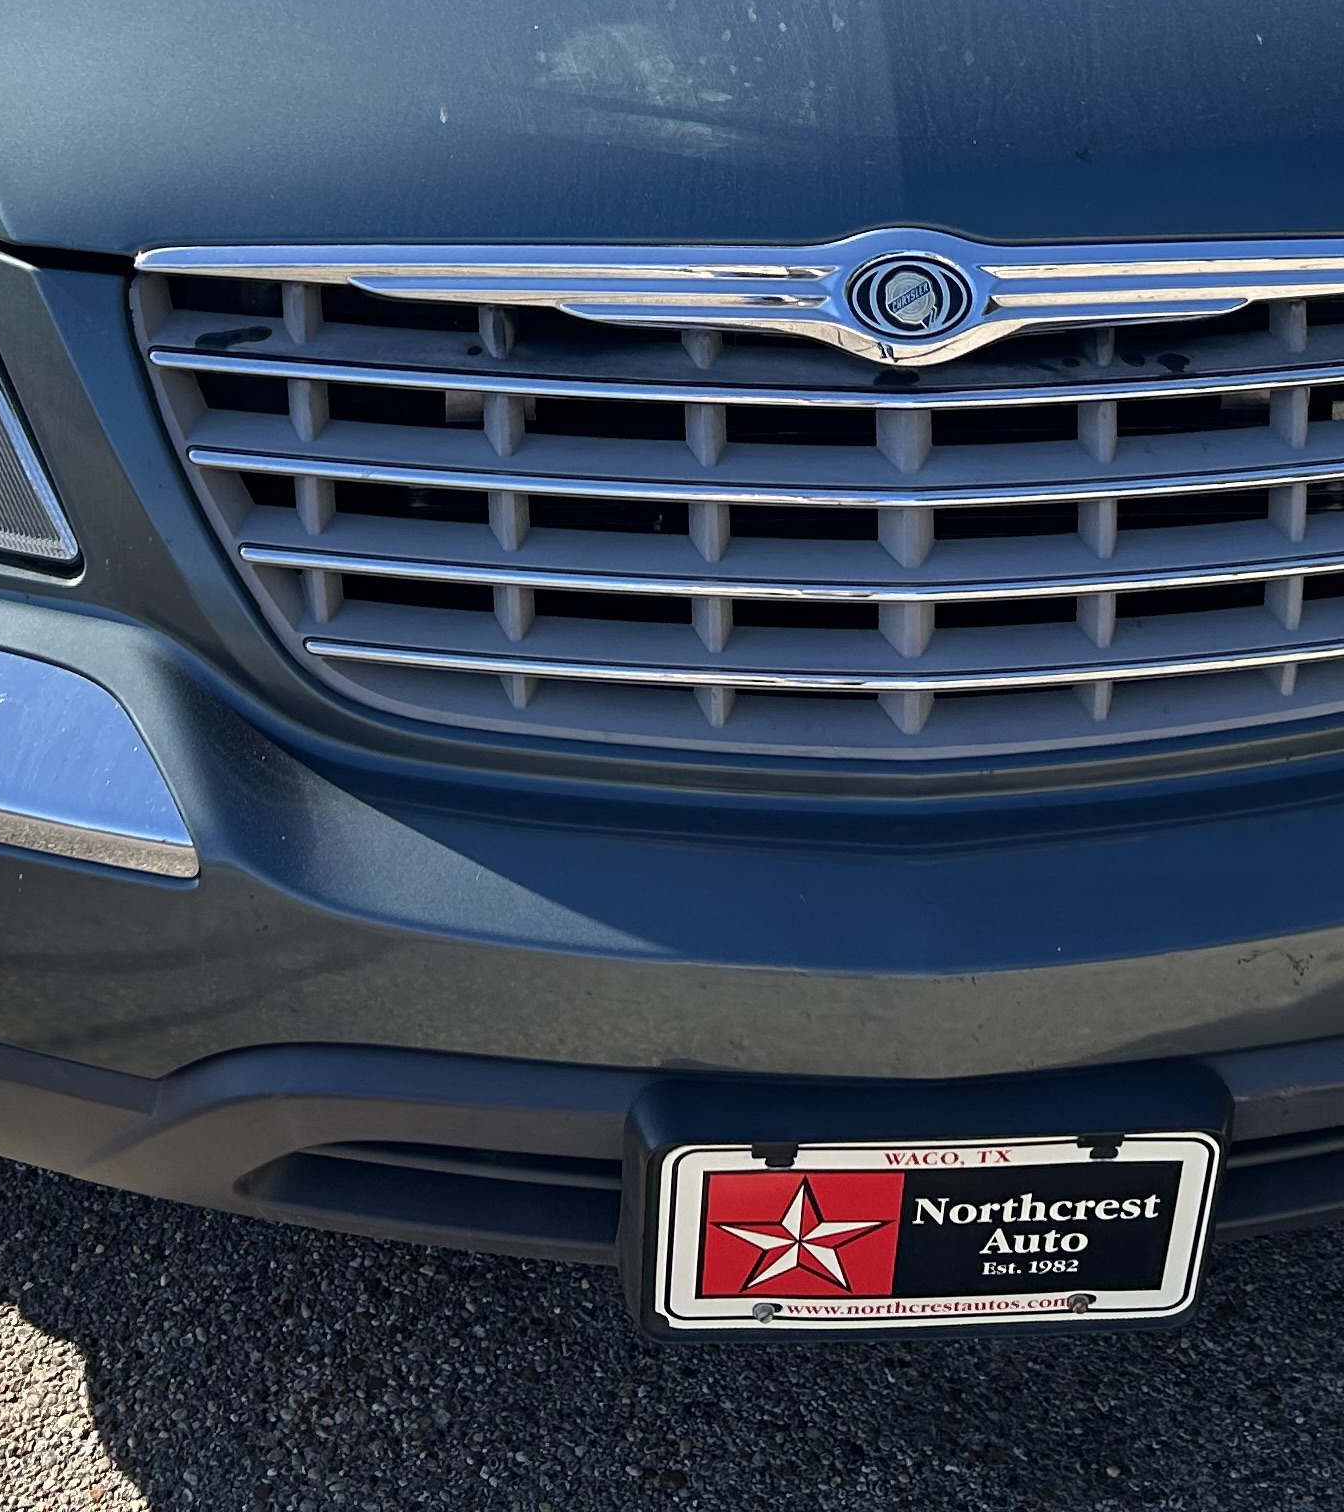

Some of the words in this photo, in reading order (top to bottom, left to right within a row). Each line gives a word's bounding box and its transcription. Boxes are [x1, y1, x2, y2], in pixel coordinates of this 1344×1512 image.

[891, 281, 929, 314] CHRYSLER
[884, 1151, 965, 1166] WACO,
[977, 1149, 1012, 1164] TX
[911, 1192, 1161, 1226] Northcrest
[978, 1227, 1089, 1255] Auto
[981, 1261, 1023, 1276] Est.
[1028, 1259, 1079, 1275] 1982
